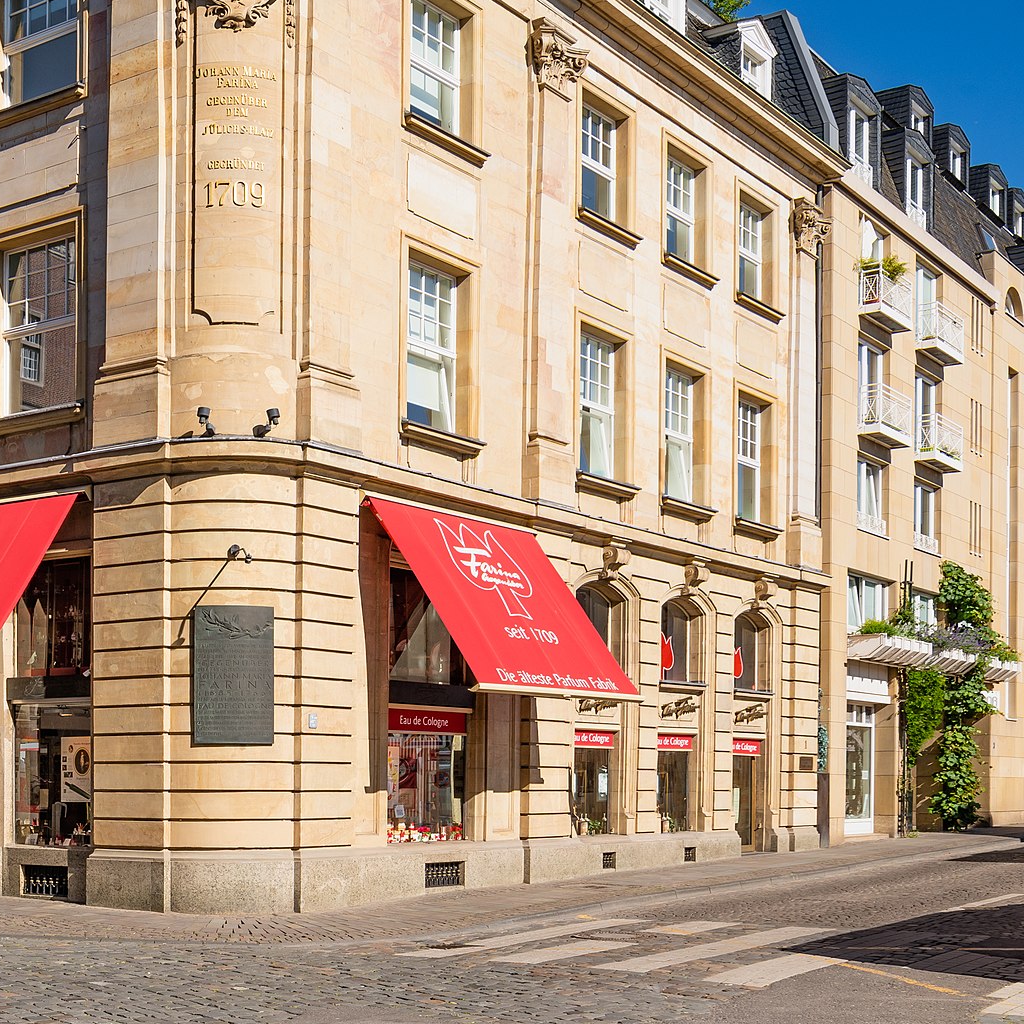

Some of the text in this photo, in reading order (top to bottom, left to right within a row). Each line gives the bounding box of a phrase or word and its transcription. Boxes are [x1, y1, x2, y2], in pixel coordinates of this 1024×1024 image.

[195, 67, 239, 79] JOHANN
[206, 94, 268, 108] GEGENÜBER
[226, 107, 249, 117] DEM
[207, 158, 265, 171] GEGRÜNDET
[203, 180, 266, 208] 1709
[453, 546, 521, 580] Farina
[504, 624, 559, 645] seit 1709
[198, 681, 272, 689] FARINA
[495, 667, 619, 690] Die älteste Parfum Fabrik
[399, 715, 449, 729] Eau de Cologne
[581, 733, 588, 742] de
[588, 733, 610, 744] Cologne
[663, 737, 669, 745] de
[669, 737, 689, 747] Cologne
[741, 743, 757, 752] Cologne
